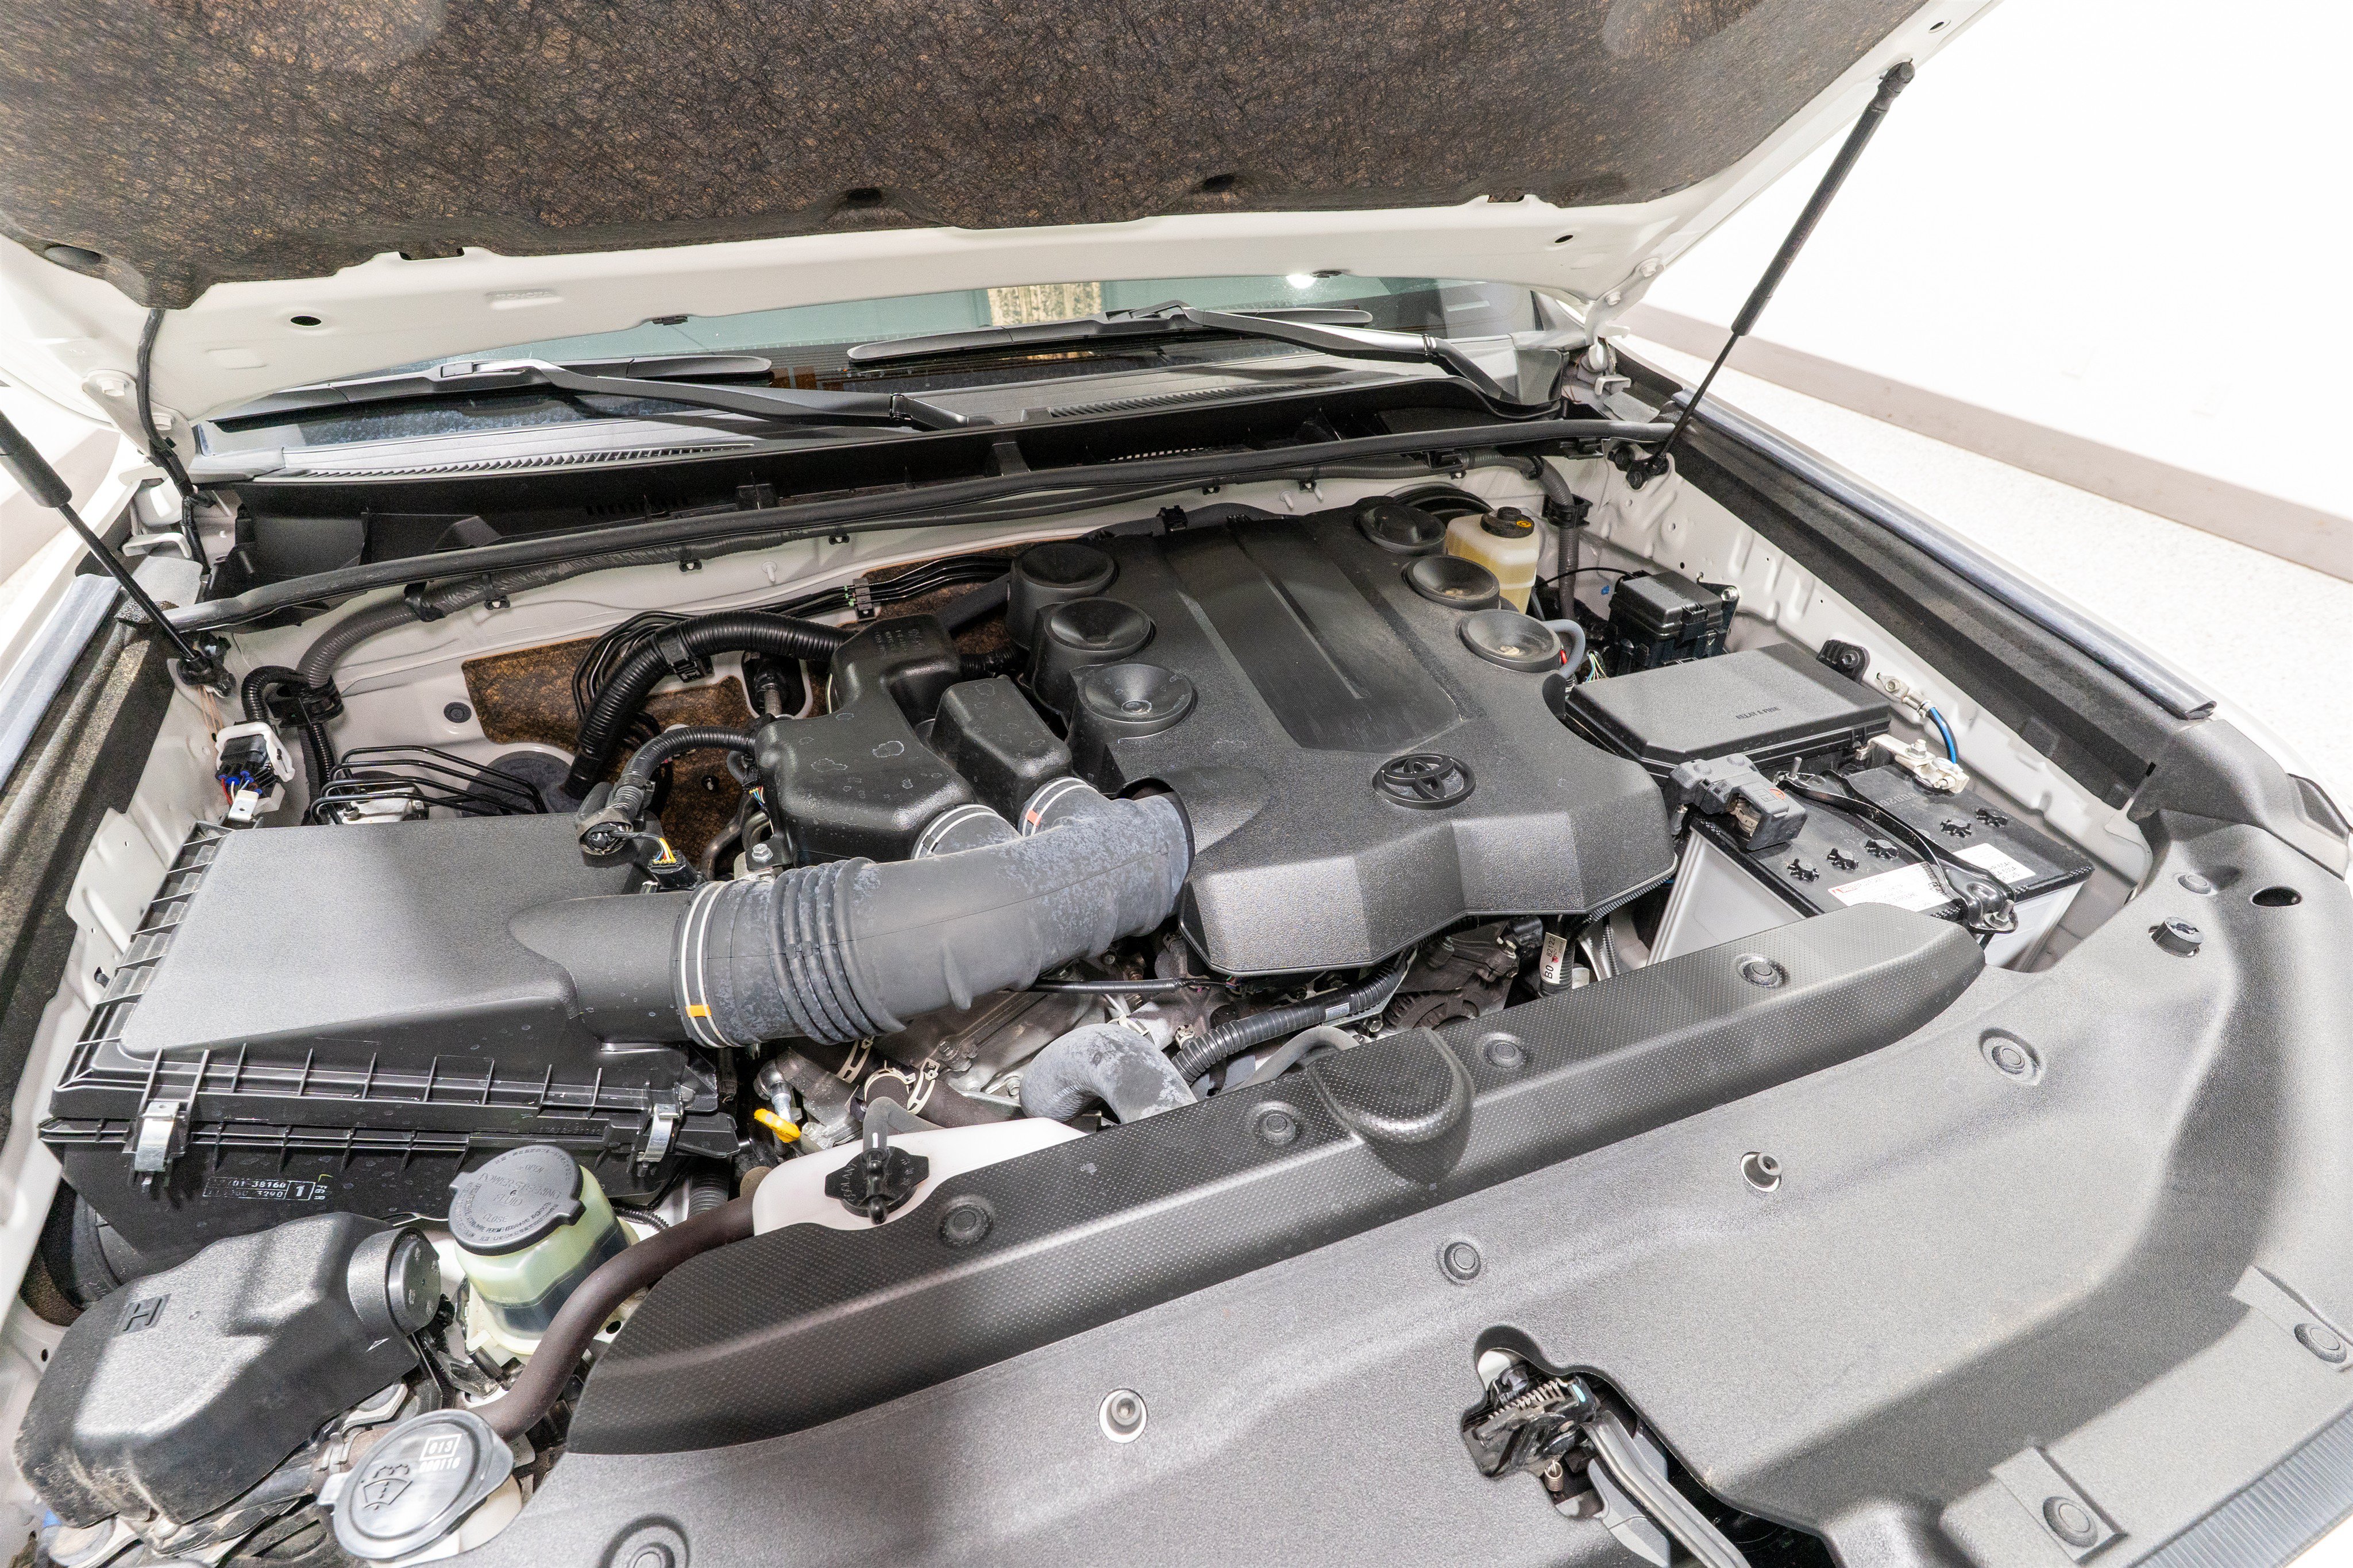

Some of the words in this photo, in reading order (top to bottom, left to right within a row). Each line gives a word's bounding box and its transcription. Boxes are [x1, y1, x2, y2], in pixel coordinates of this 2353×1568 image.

[1546, 936, 1556, 957] 82122
[525, 1164, 545, 1173] OPEN
[479, 1173, 515, 1189] POWER
[296, 1184, 304, 1197] 1
[493, 1194, 523, 1207] FLUID
[483, 1213, 510, 1223] CLOSE
[122, 1297, 164, 1332] H
